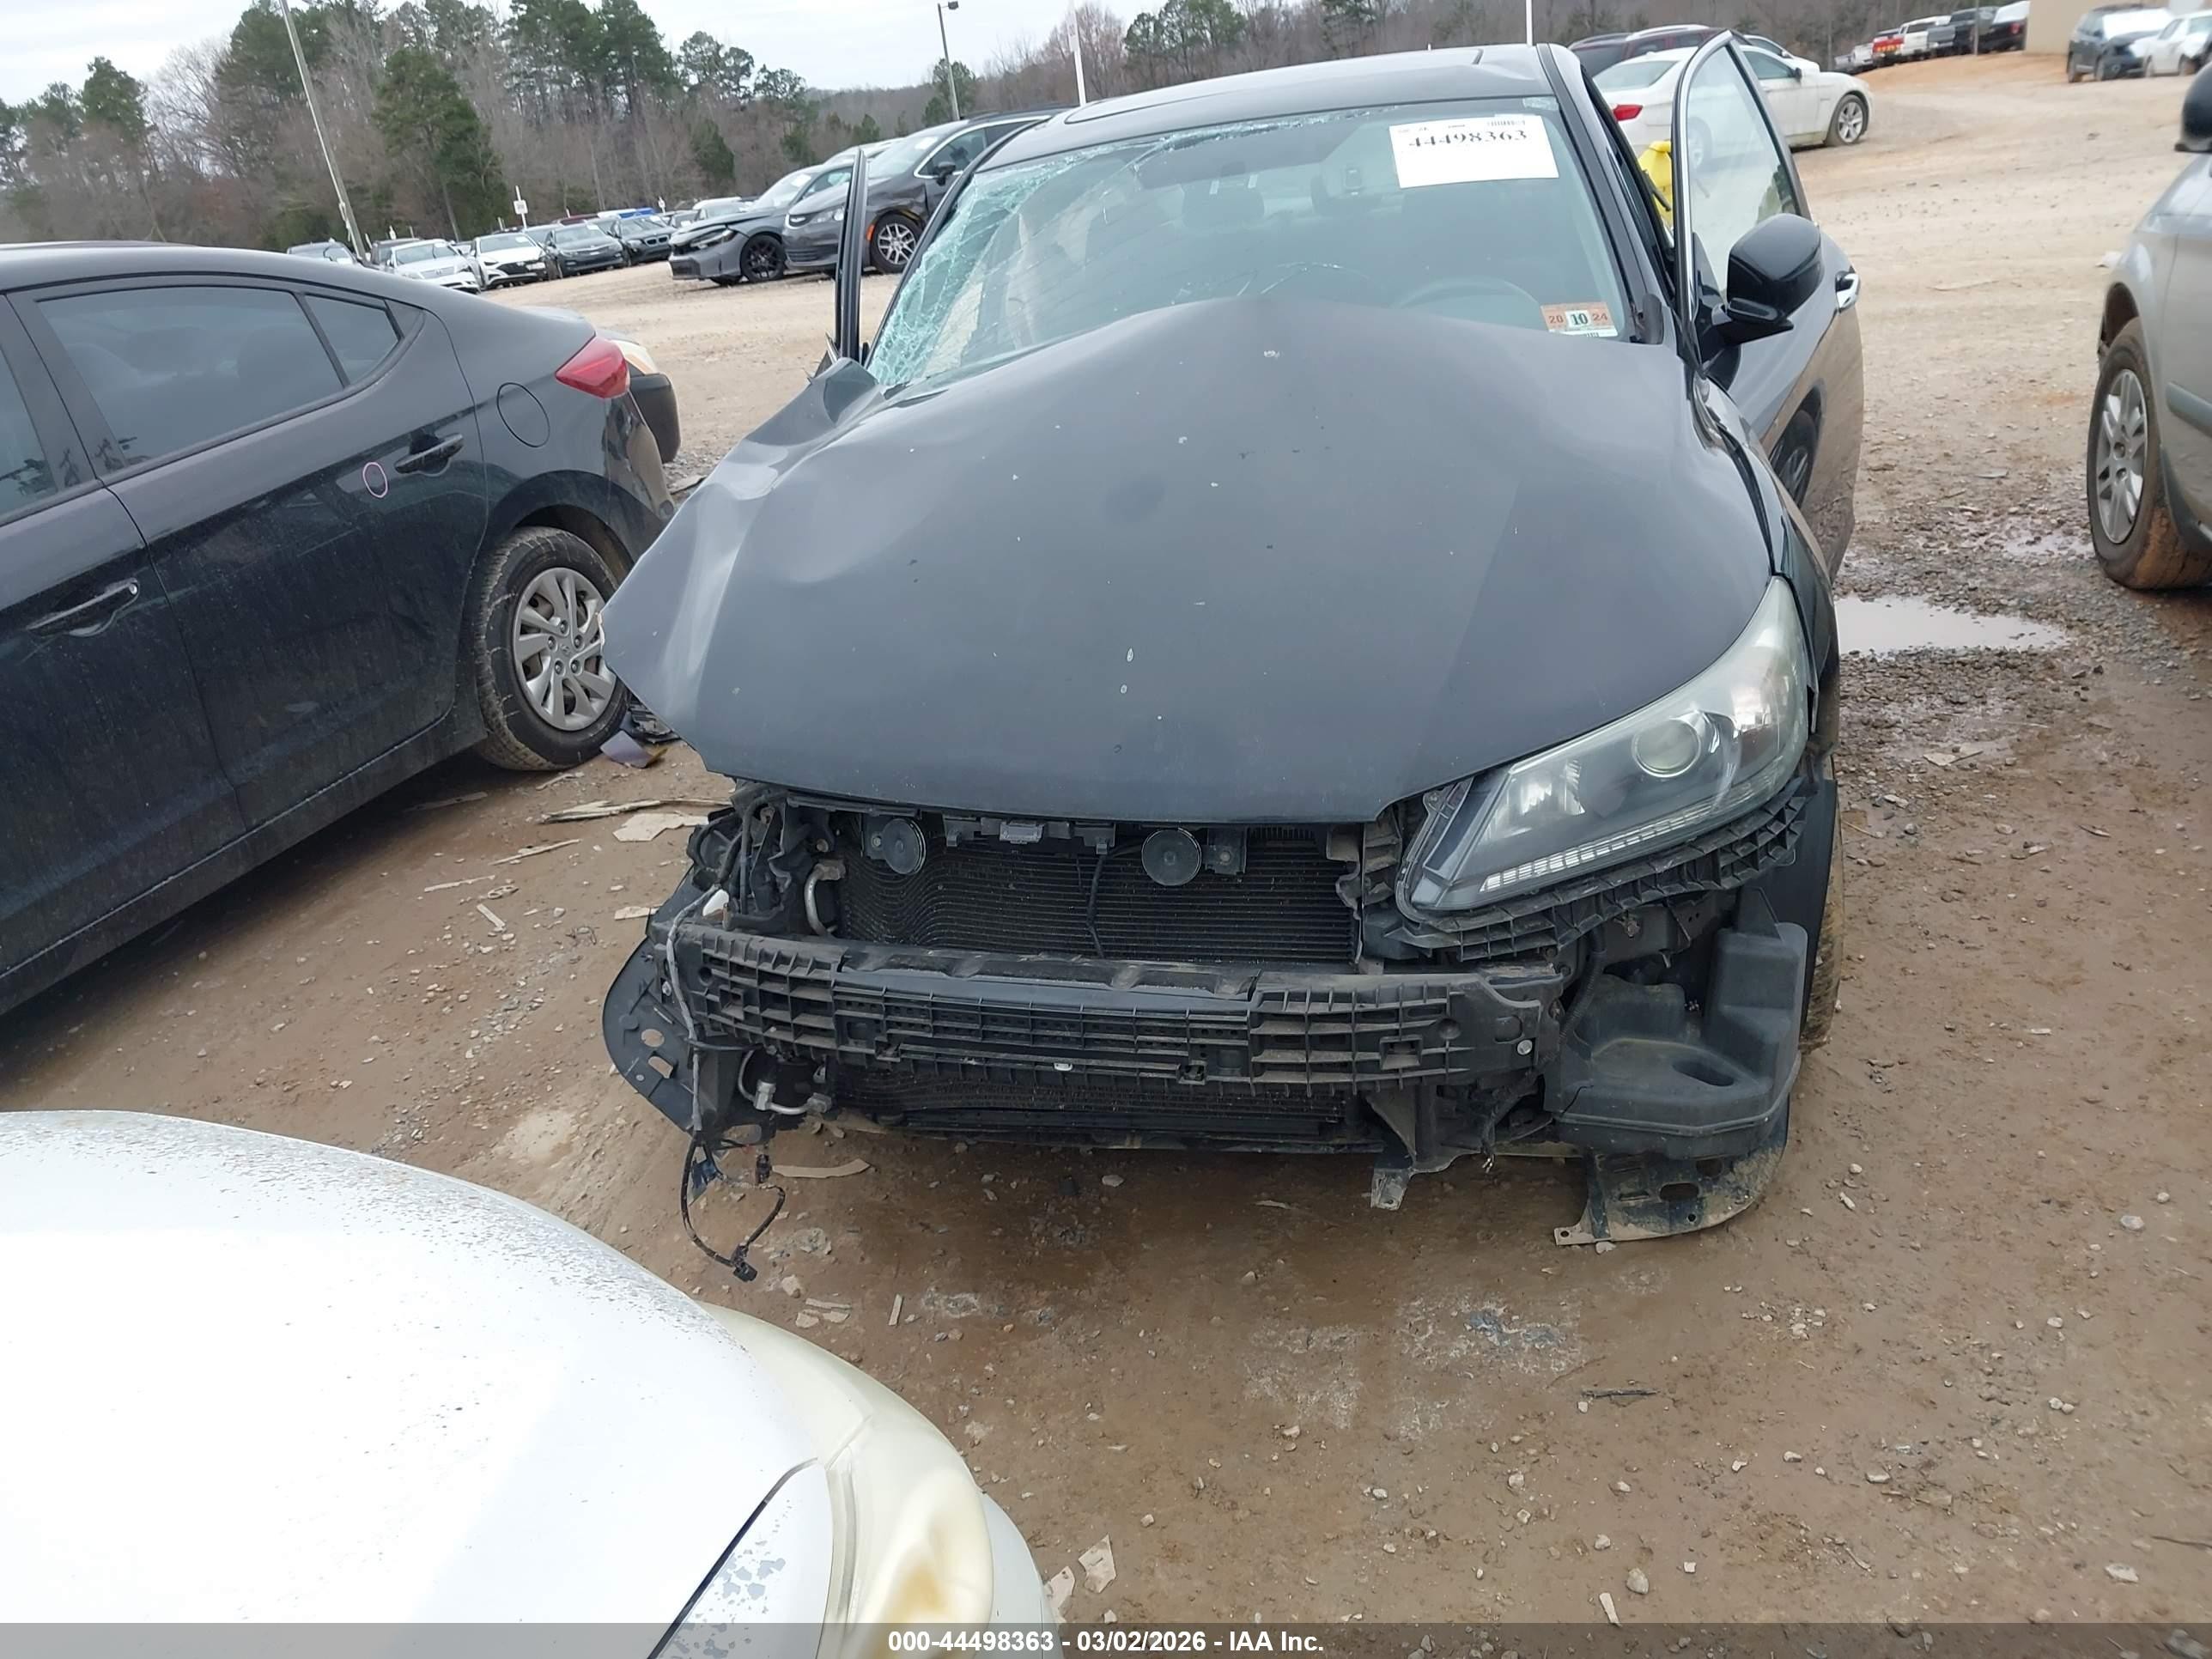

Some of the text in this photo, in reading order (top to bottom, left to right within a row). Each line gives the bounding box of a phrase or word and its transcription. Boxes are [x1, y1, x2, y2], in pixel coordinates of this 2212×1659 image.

[1409, 130, 1527, 147] 44498363
[1548, 312, 1608, 325] 20 10 24
